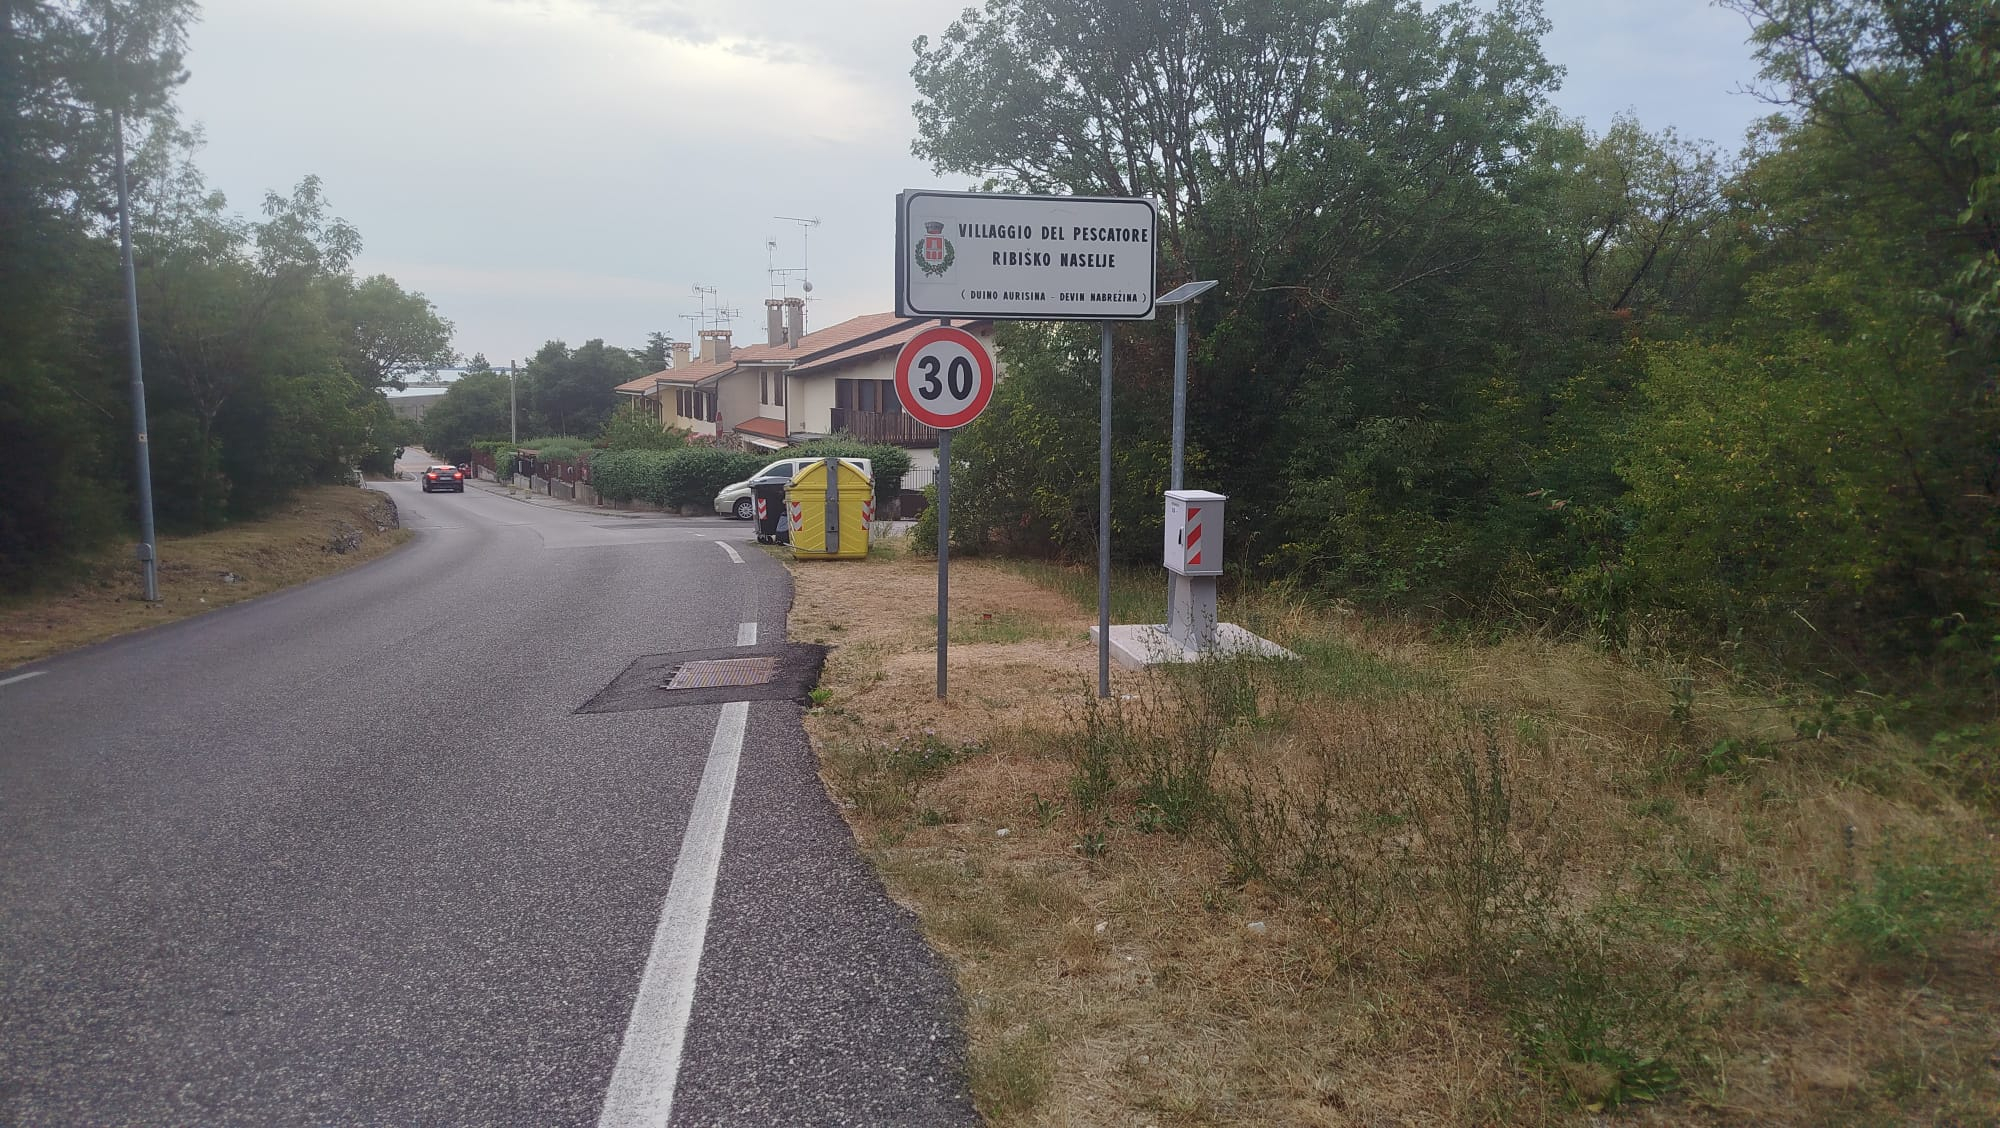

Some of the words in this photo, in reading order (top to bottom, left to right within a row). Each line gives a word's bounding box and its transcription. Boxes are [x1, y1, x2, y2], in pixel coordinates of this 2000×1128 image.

[959, 223, 1032, 240] VILLAGGIO
[1041, 226, 1065, 241] DEL
[1073, 227, 1149, 243] PESCATORE
[992, 248, 1051, 267] RIBIŠKO
[1060, 253, 1116, 268] NASELJE
[970, 290, 998, 300] DUINO
[1003, 291, 1046, 301] AURISINA
[1059, 292, 1085, 302] DEVIN
[918, 355, 973, 401] 30
